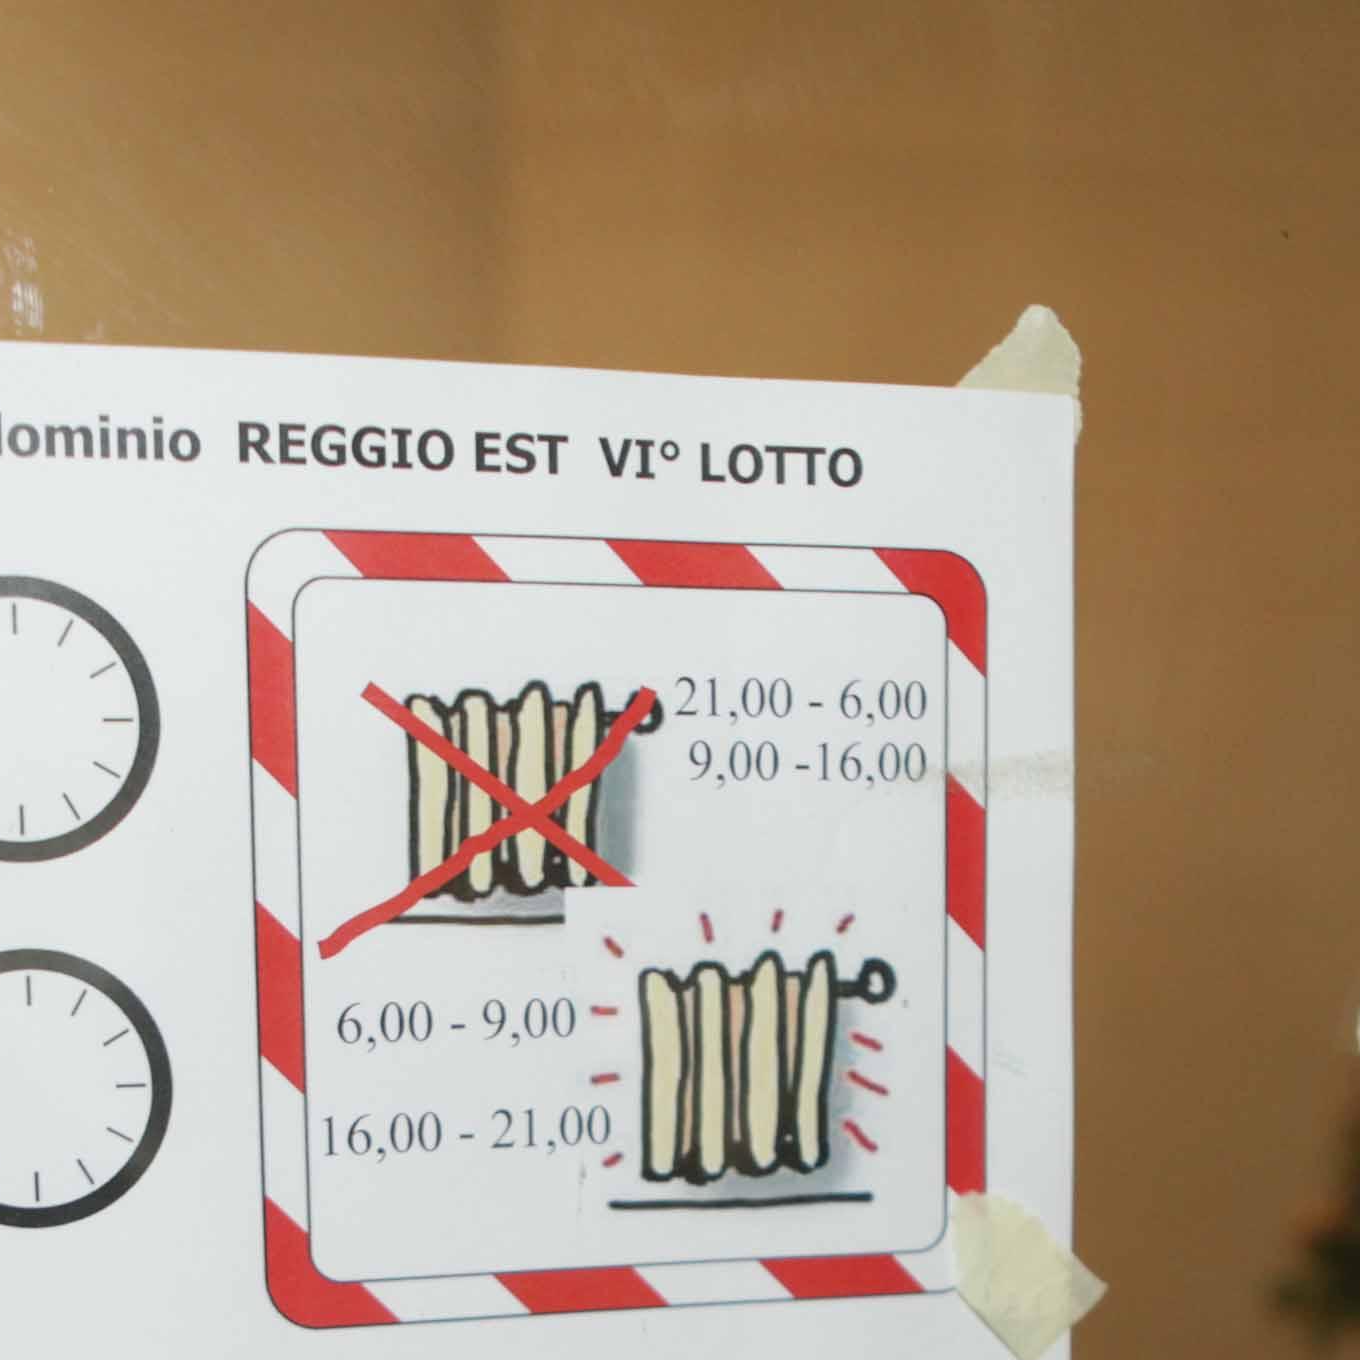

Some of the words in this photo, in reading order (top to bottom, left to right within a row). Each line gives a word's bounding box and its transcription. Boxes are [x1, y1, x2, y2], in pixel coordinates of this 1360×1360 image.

[238, 421, 455, 471] REGGIO
[473, 431, 569, 475] EST
[599, 436, 680, 480] VI°
[700, 442, 864, 488] LOTTO
[675, 676, 793, 725] 21,00
[840, 679, 928, 727] 6,00
[689, 740, 780, 790] 9,00
[337, 1000, 434, 1053] 6,00
[482, 996, 577, 1048] 9,00
[323, 1110, 443, 1164] 16,00
[491, 1104, 612, 1157] 21,00
